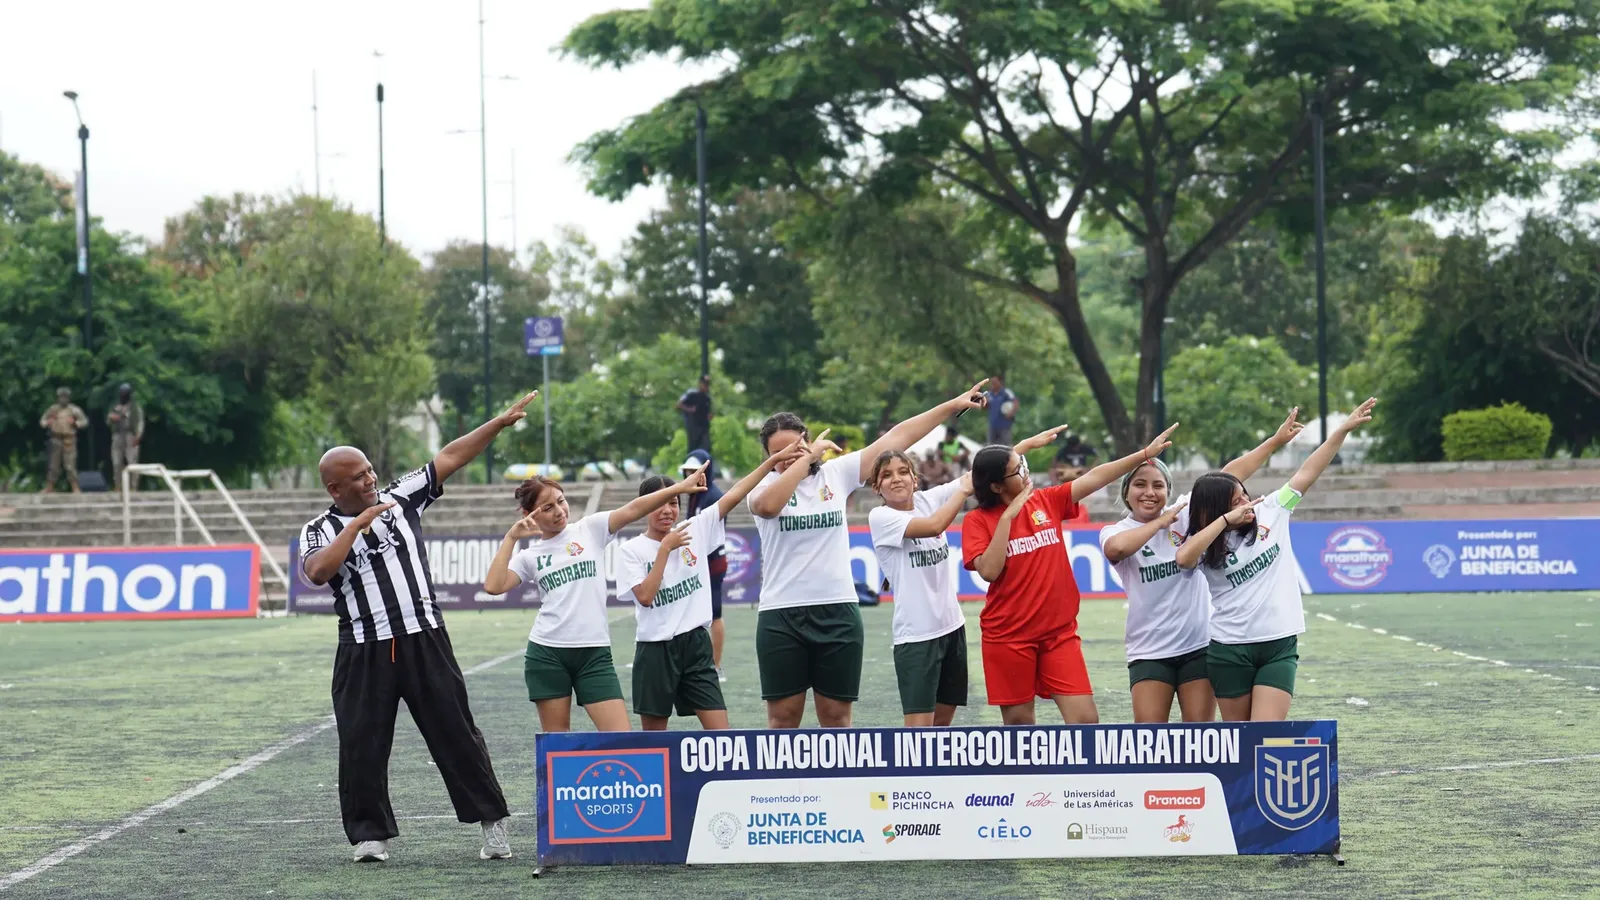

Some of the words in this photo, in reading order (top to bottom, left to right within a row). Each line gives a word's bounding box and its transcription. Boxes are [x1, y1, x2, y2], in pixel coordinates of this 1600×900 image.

[1457, 530, 1514, 540] Presentado
[1006, 528, 1060, 557] UNGURAHUA
[1324, 552, 1389, 564] marathon
[1460, 545, 1515, 560] JUNTA
[1517, 545, 1539, 559] DE
[535, 554, 552, 571] 17
[1461, 560, 1577, 575] BENEFICENCIA
[1139, 560, 1181, 584] TUNGUR
[680, 736, 750, 772] COPA
[756, 732, 887, 770] NACIONAL
[894, 730, 1088, 767] INTERCOLEGIAL
[1095, 728, 1240, 765] MARATHON
[556, 781, 662, 801] marathon
[892, 791, 932, 800] BANCO
[1063, 789, 1116, 798] Universidad
[750, 795, 801, 804] Presentado
[803, 794, 821, 804] por:
[892, 801, 955, 810] PICHINCHA
[965, 793, 1015, 807] deuna!
[1064, 800, 1075, 808] de
[1077, 800, 1092, 808] Las
[1093, 799, 1133, 808] Américas
[1148, 794, 1201, 806] Pronaca
[587, 803, 634, 816] SPORTS
[747, 812, 802, 827] JUNTA
[806, 812, 827, 826] DE
[894, 823, 941, 836] SPORADE
[1085, 823, 1128, 835] Hispana
[747, 829, 865, 845] BENEFICENCIA
